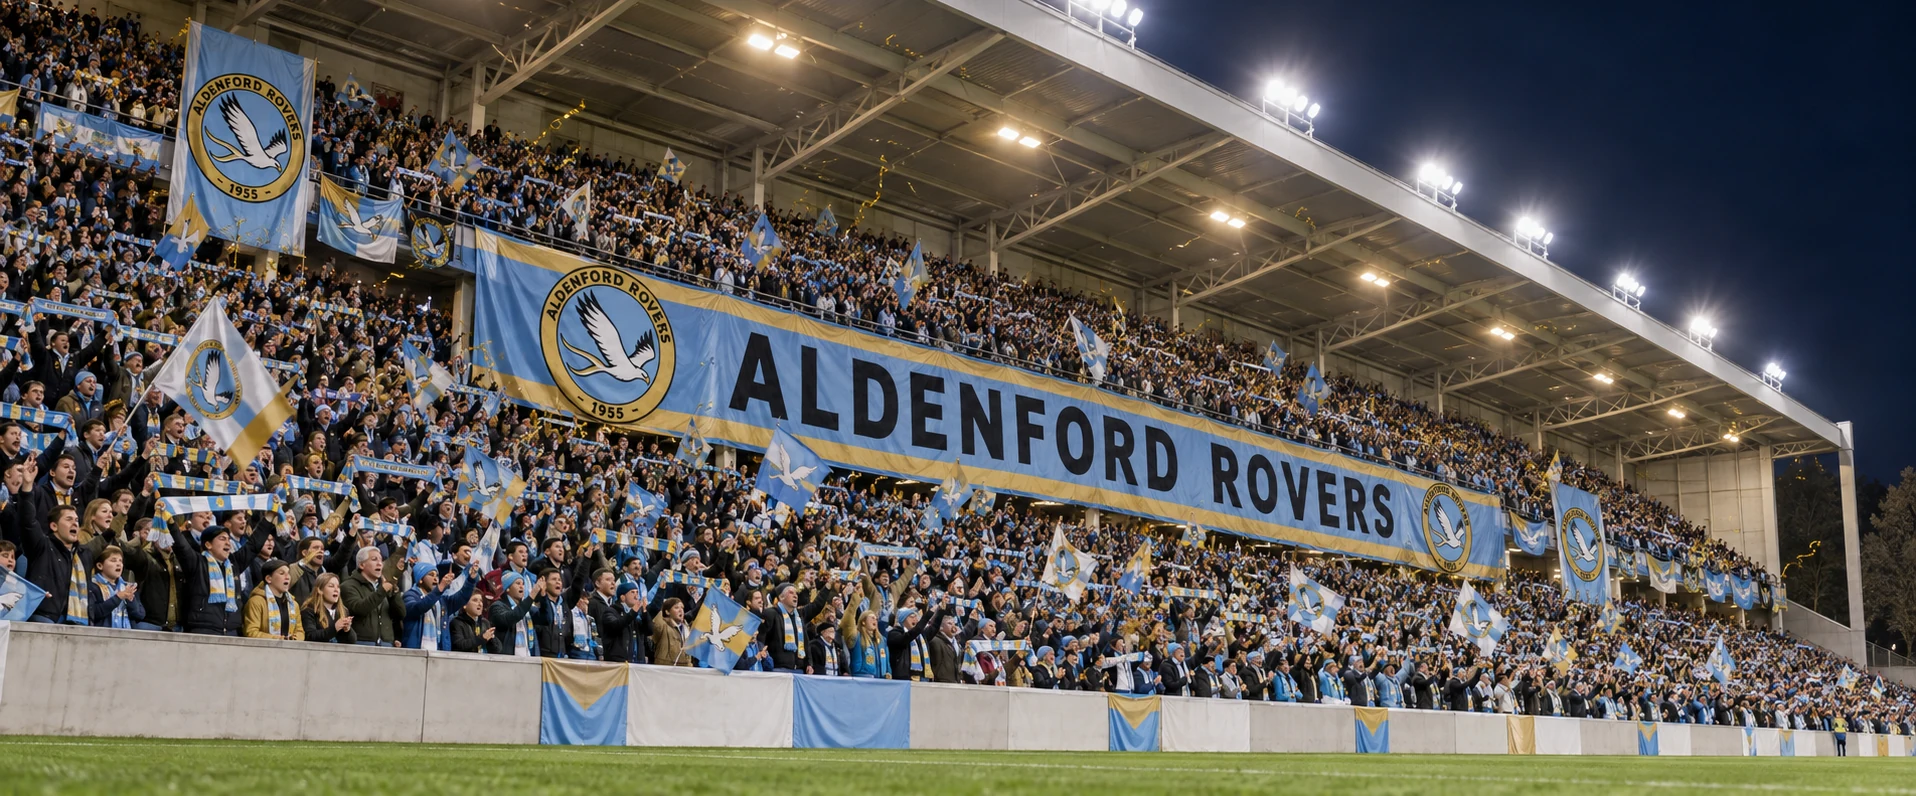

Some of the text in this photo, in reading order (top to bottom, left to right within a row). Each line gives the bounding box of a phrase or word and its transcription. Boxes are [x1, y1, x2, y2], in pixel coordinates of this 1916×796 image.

[193, 77, 263, 116] ALDENFORD
[229, 183, 259, 200] 1955
[546, 270, 671, 344] ALDENFORD ROVERS
[591, 401, 625, 420] 1955
[729, 331, 1394, 539] ALDENFORD ROVERS
